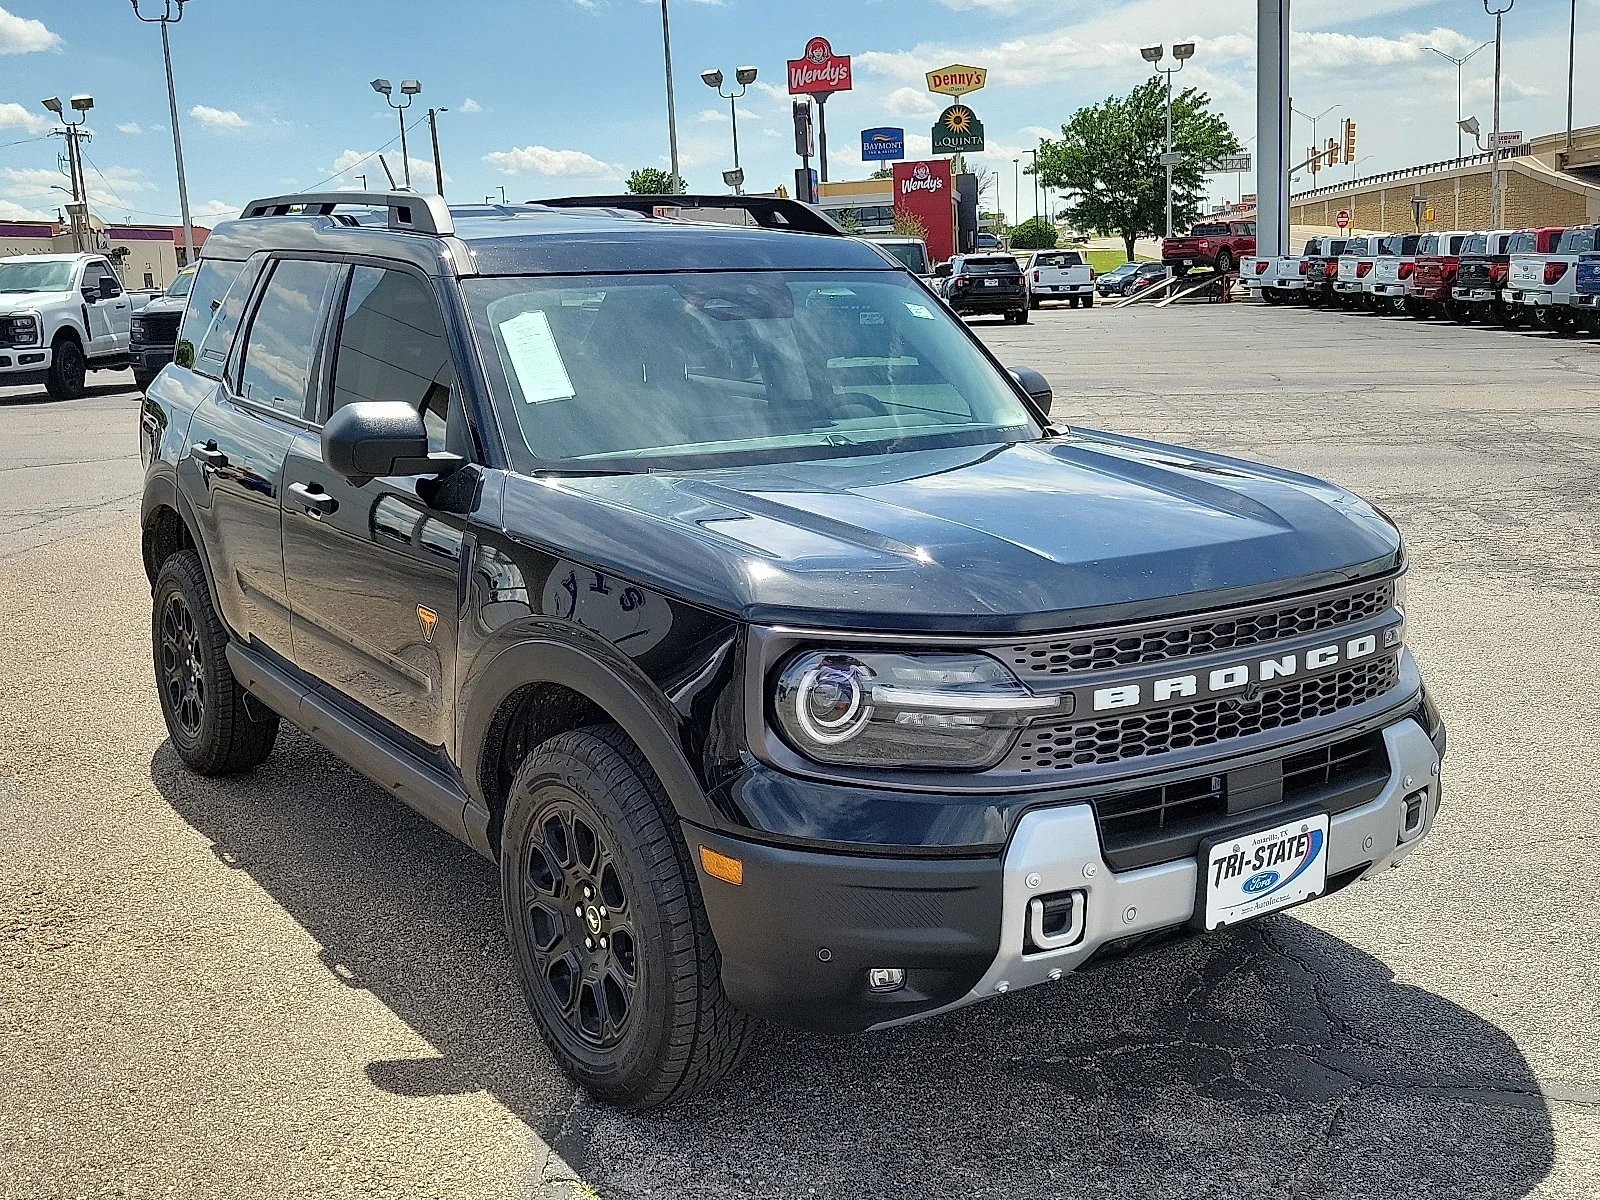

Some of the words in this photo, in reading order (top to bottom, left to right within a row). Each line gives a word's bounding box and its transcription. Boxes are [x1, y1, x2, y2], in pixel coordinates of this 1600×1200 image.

[791, 60, 849, 89] Wendy's
[932, 71, 982, 88] Denny's
[863, 142, 902, 150] BAYMONT
[942, 136, 983, 147] QUINTA
[902, 175, 943, 194] Wendy's
[1093, 634, 1376, 711] BRONCO
[1212, 833, 1308, 889] TRI-STATE
[1249, 875, 1274, 891] Ford
